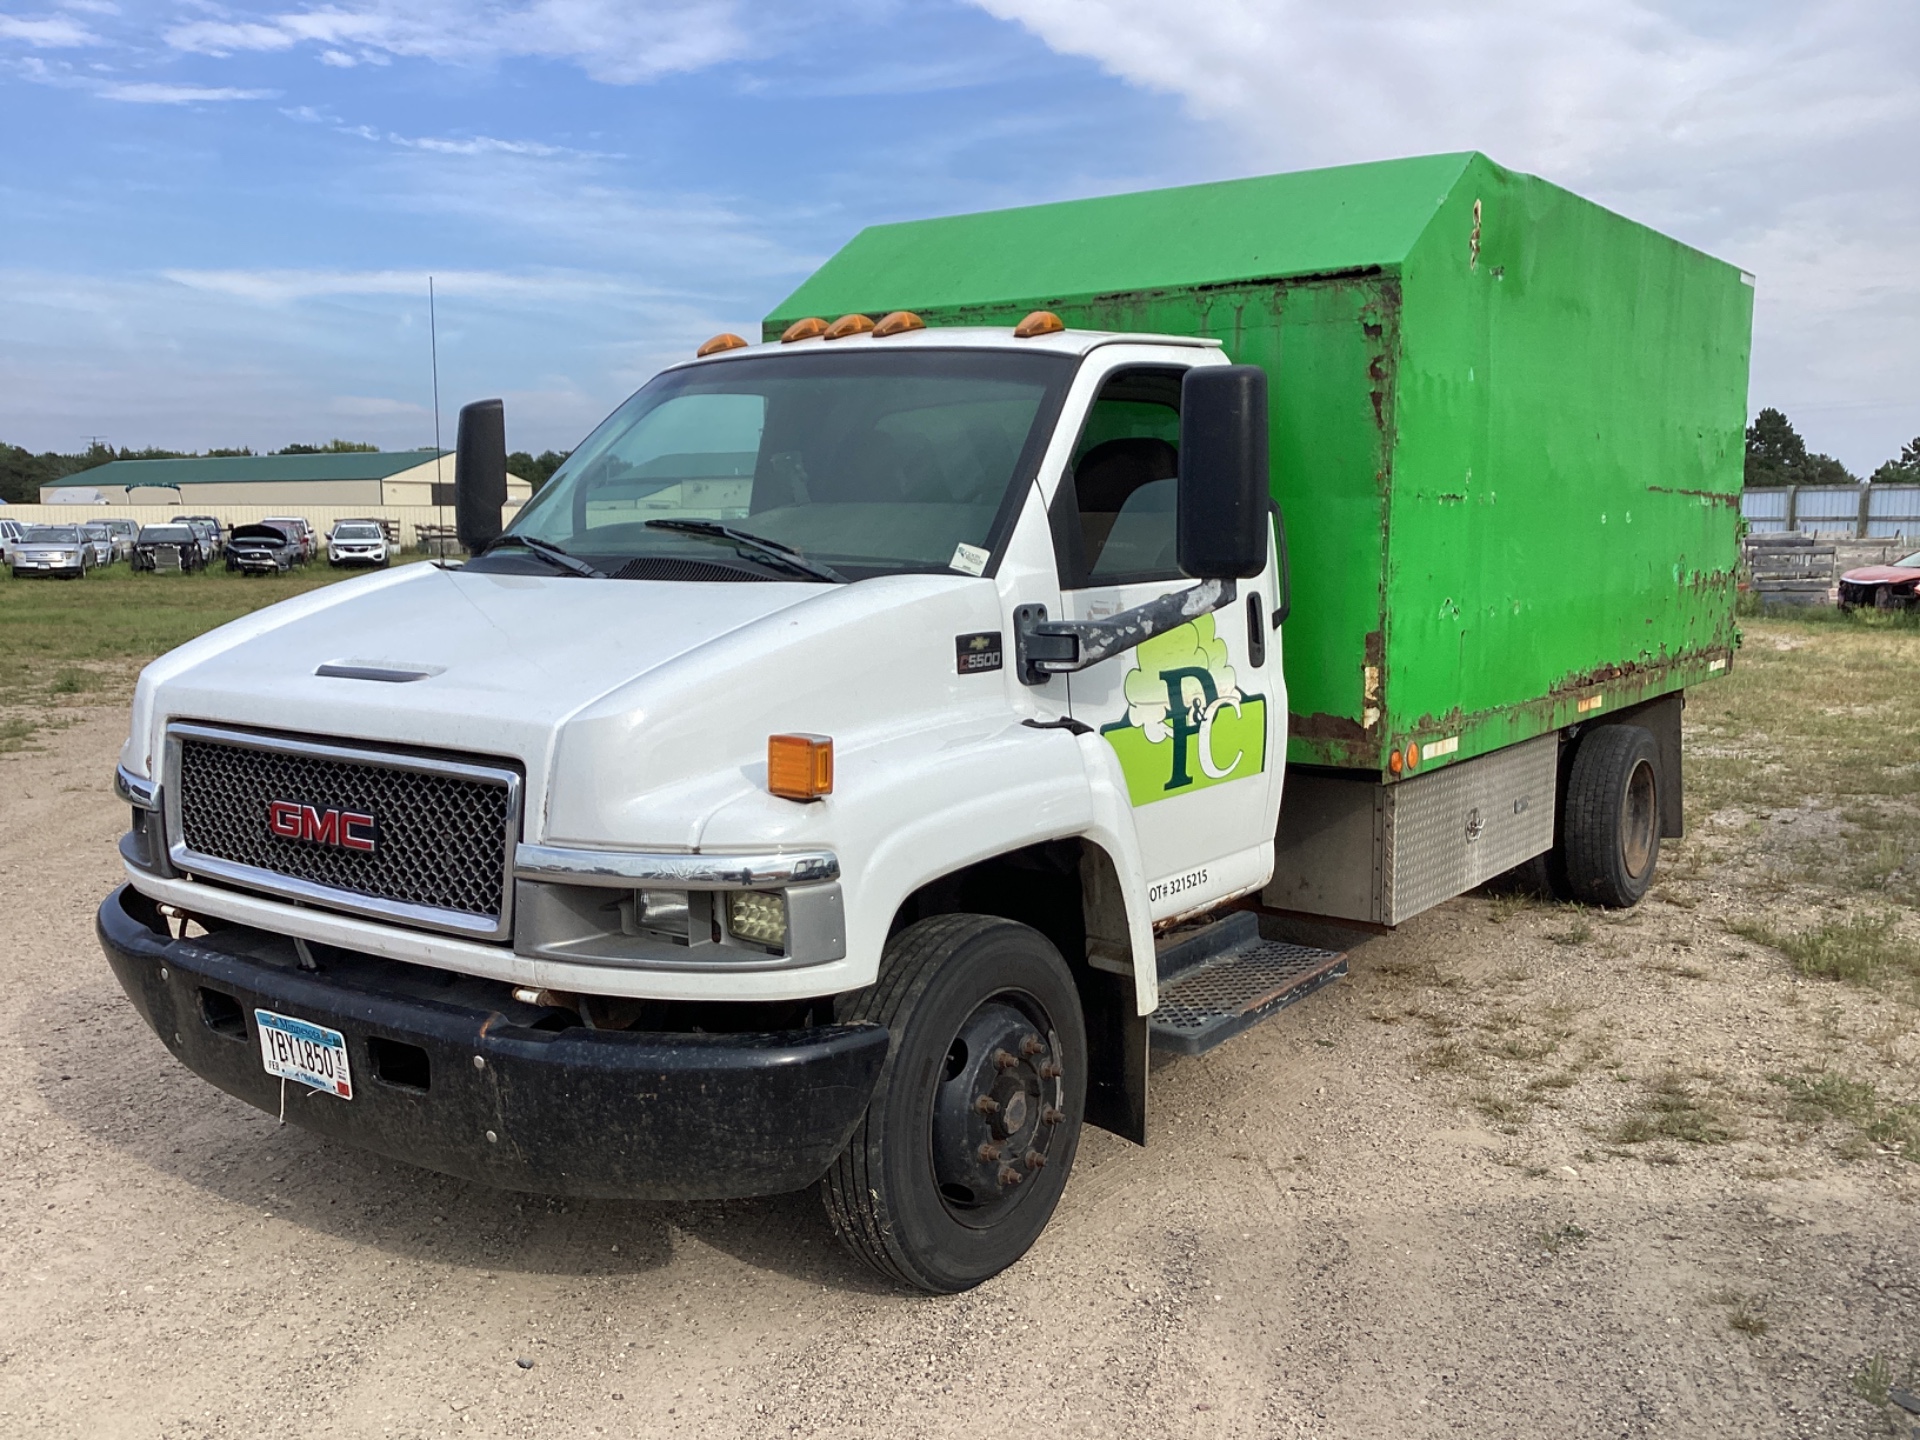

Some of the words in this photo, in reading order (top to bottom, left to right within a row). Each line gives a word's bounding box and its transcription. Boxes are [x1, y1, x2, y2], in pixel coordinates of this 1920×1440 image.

[271, 800, 375, 852] GMC
[1149, 883, 1168, 902] OT#
[1170, 869, 1208, 895] 3215215
[279, 1018, 321, 1039] Minnesota
[266, 1028, 333, 1078] YBY1850
